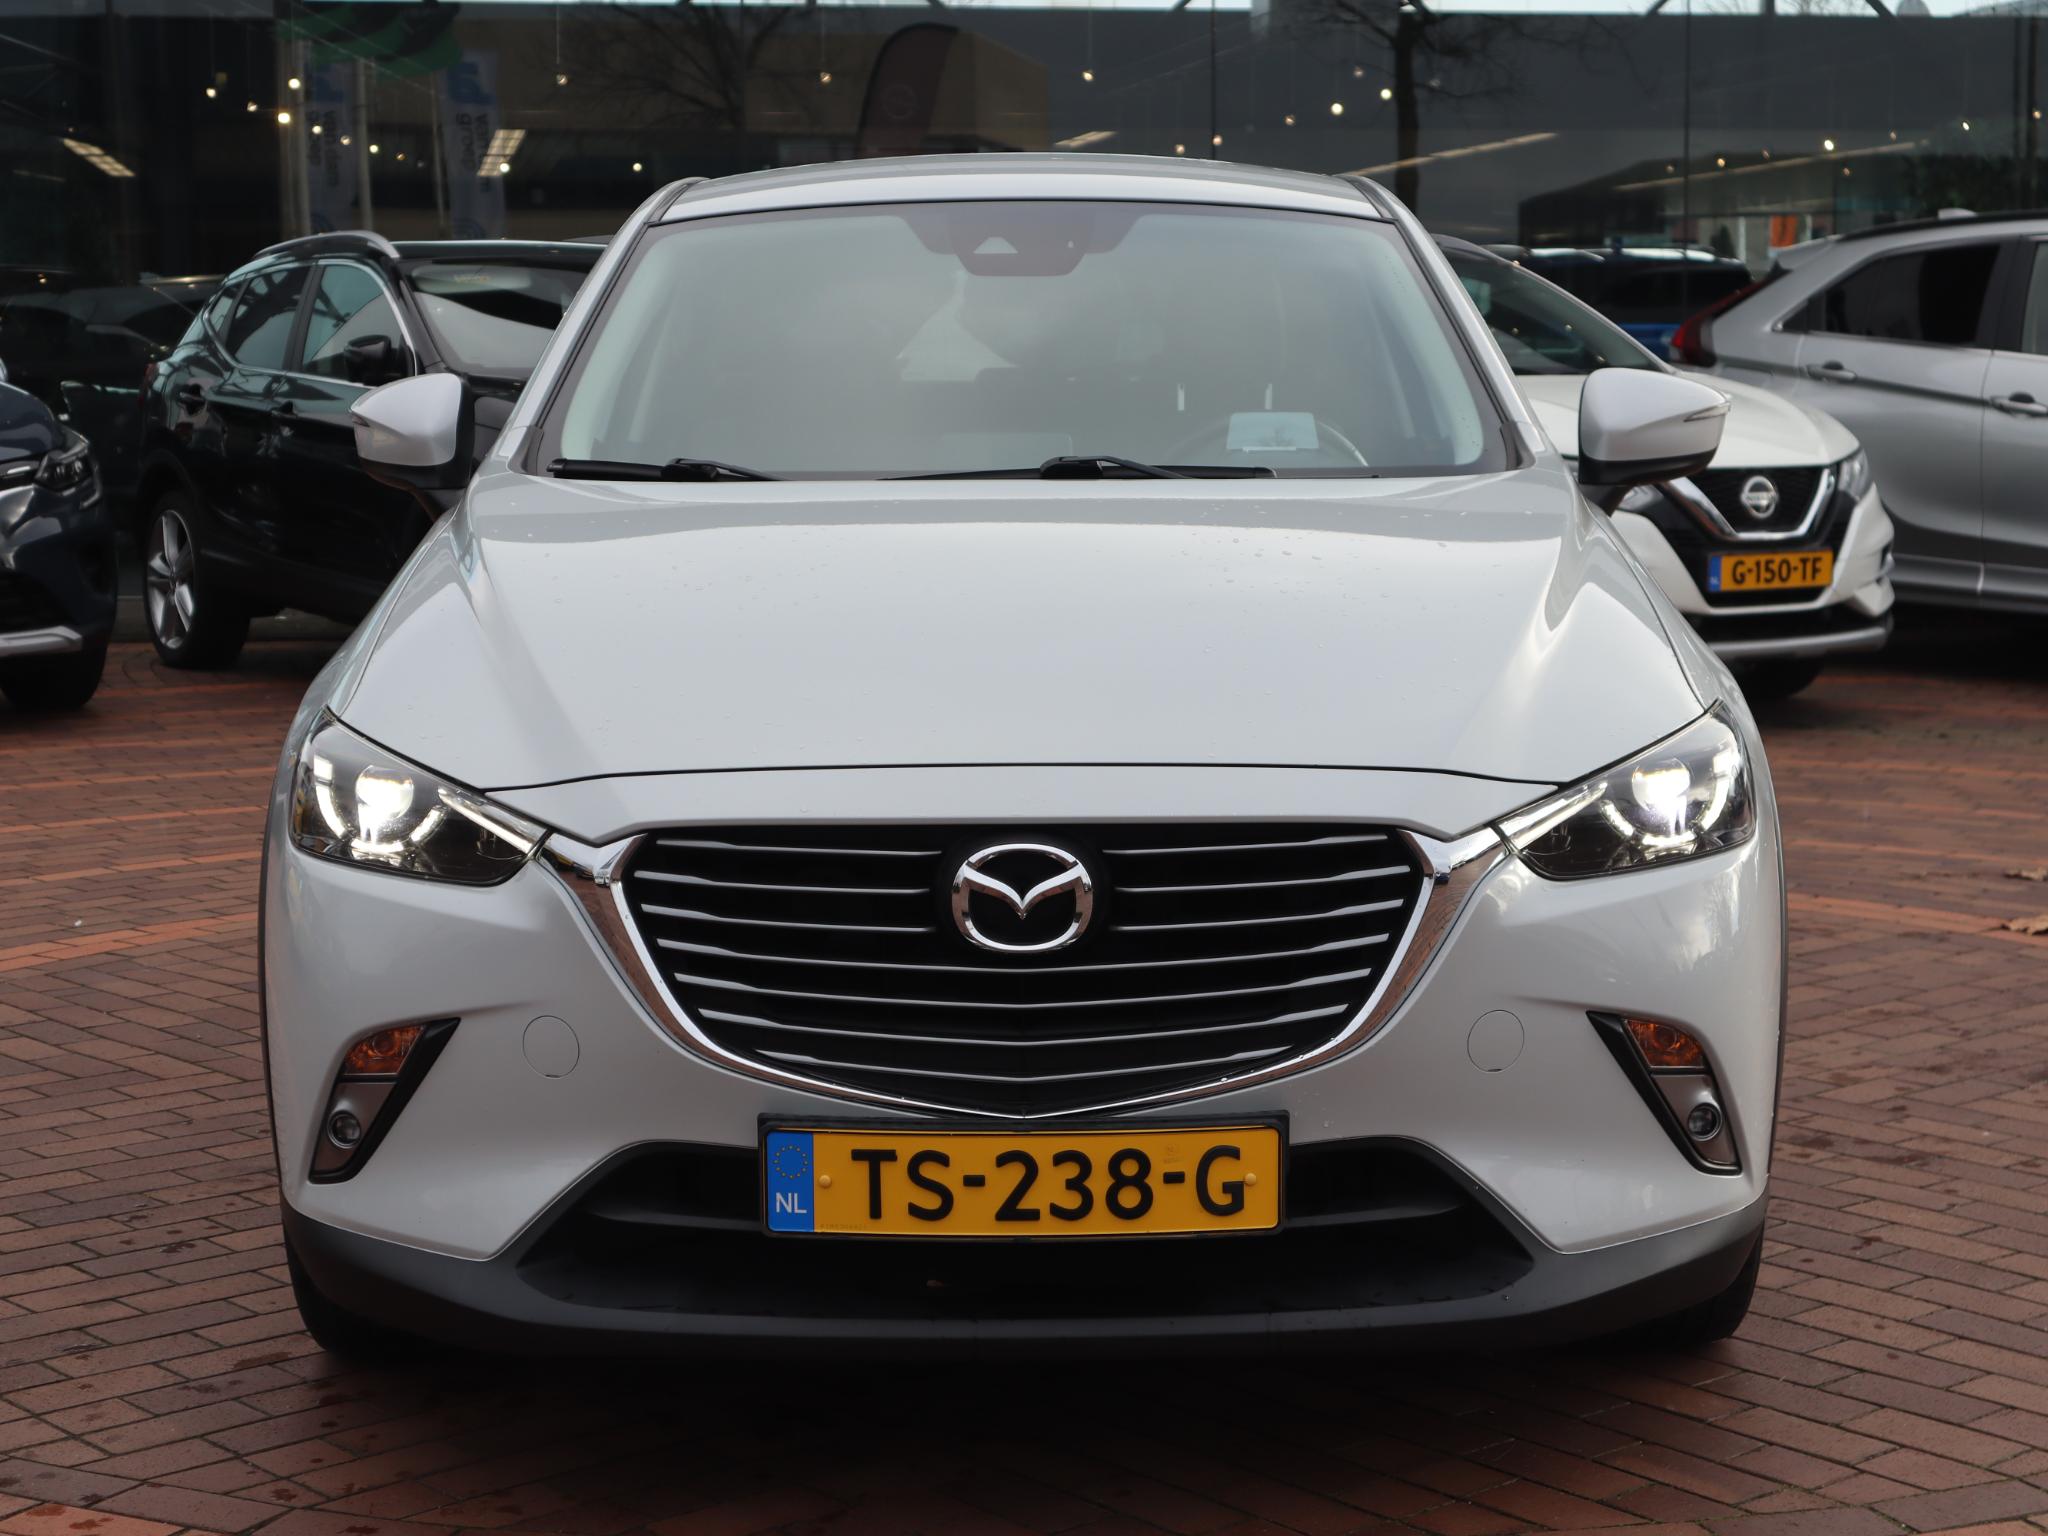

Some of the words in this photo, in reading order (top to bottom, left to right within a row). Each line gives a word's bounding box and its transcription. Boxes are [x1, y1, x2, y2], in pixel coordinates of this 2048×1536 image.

[1732, 557, 1823, 585] G-150-TF
[775, 1192, 807, 1214] NL
[851, 1144, 1245, 1221] TS-238-G
